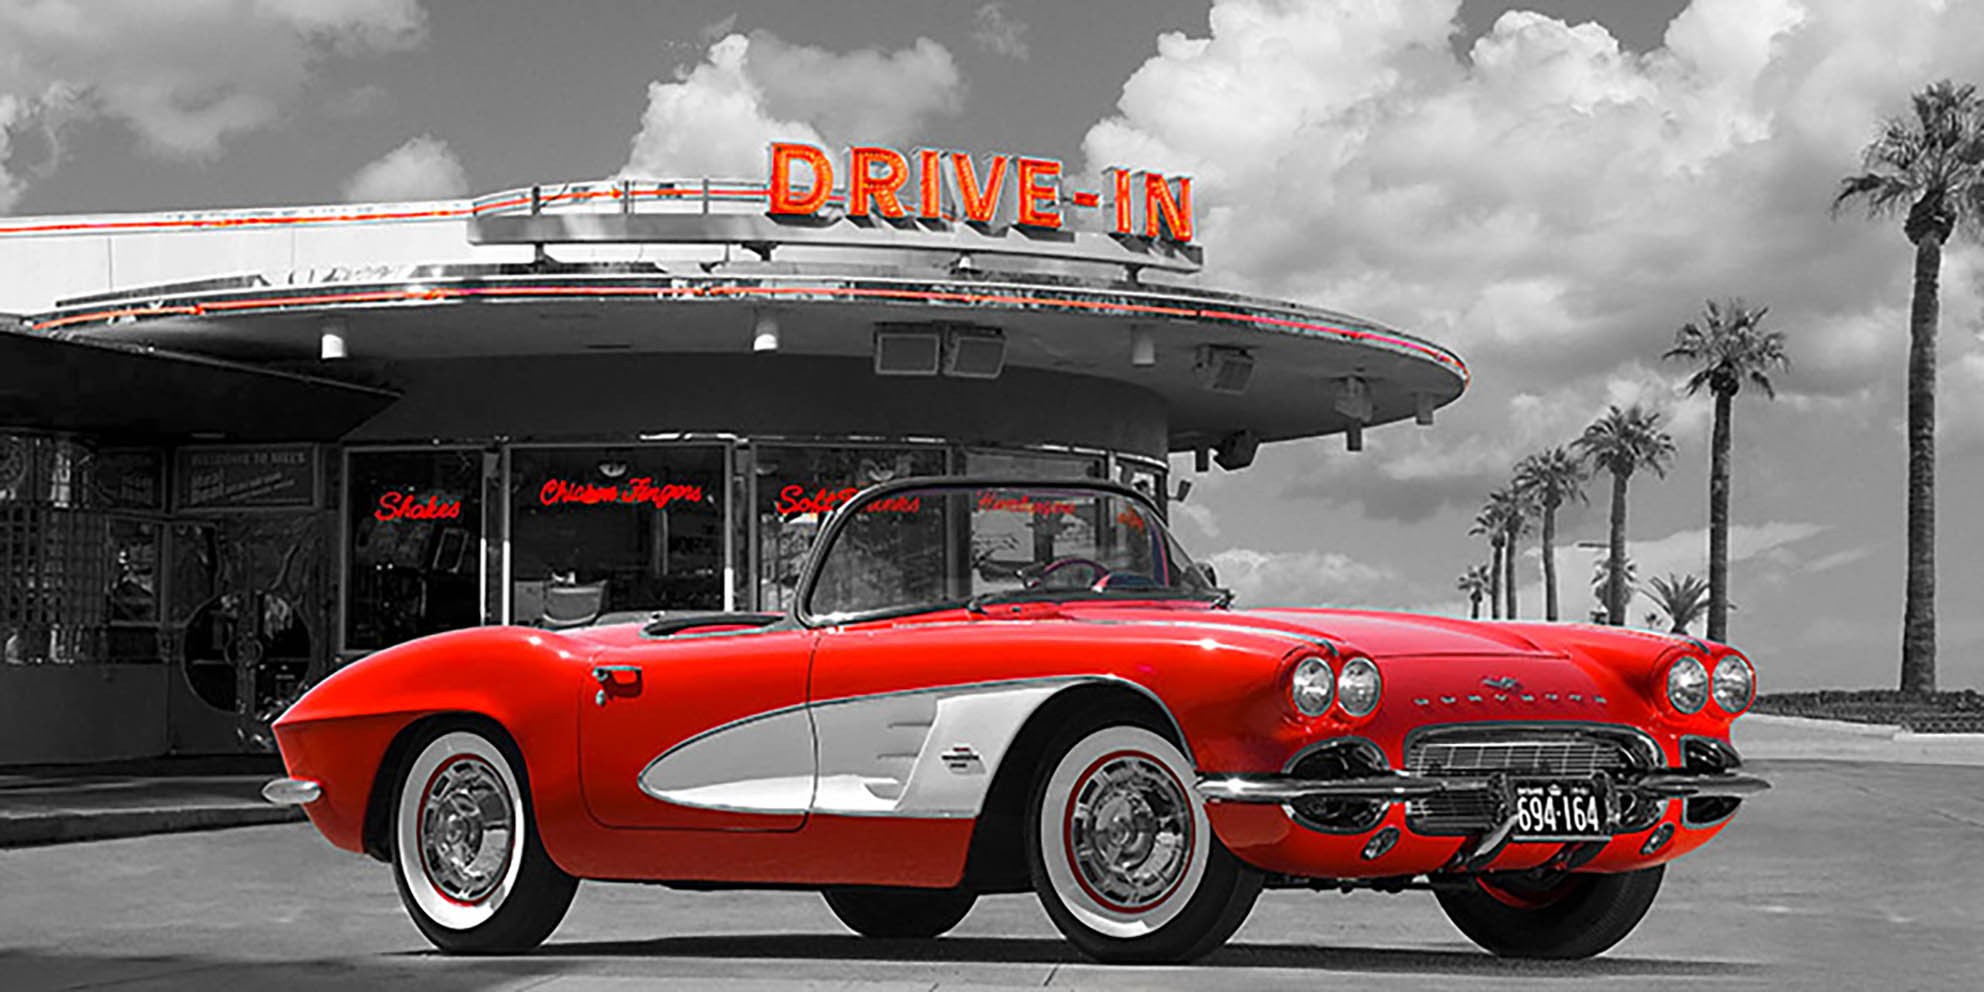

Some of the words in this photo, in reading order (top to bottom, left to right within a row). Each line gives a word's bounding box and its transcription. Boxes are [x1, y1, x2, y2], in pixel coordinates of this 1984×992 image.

[768, 142, 1194, 243] DRIVE-IN
[374, 491, 461, 521] Shakes
[540, 479, 617, 506] Chicken
[620, 478, 702, 509] Fingers
[776, 485, 835, 515] Soft
